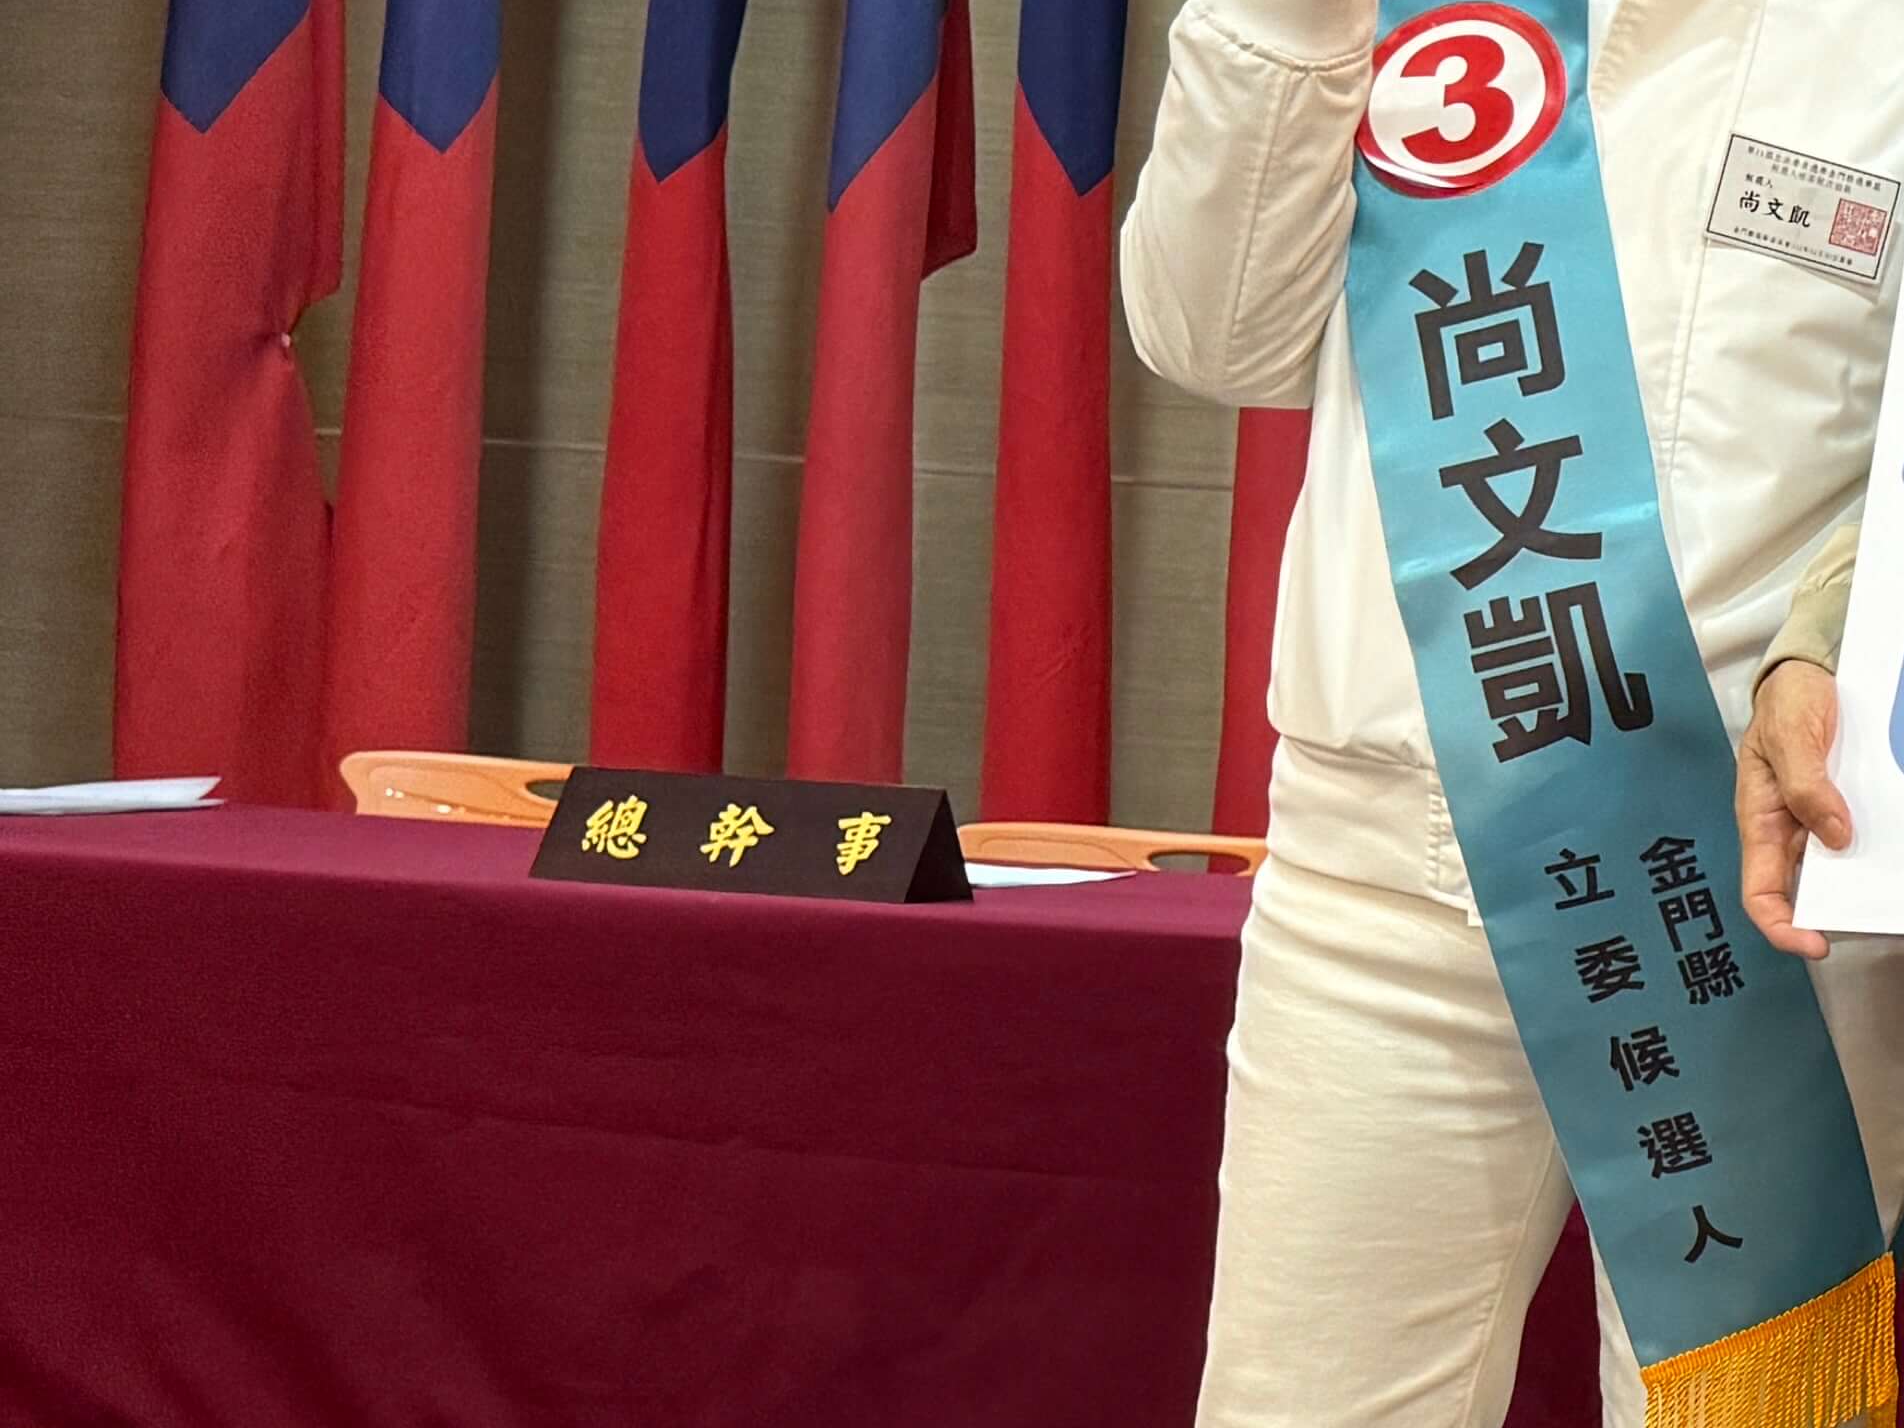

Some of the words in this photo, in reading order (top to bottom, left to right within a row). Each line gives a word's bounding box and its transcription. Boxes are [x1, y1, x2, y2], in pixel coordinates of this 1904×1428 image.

[1400, 34, 1515, 165] 3
[1738, 190, 1811, 228] 尚文凱
[1410, 242, 1655, 763] 尚文凱
[581, 794, 892, 875] 總幹事
[1639, 835, 1744, 1005] 金門縣
[1544, 848, 1743, 1264] 立委候選人
